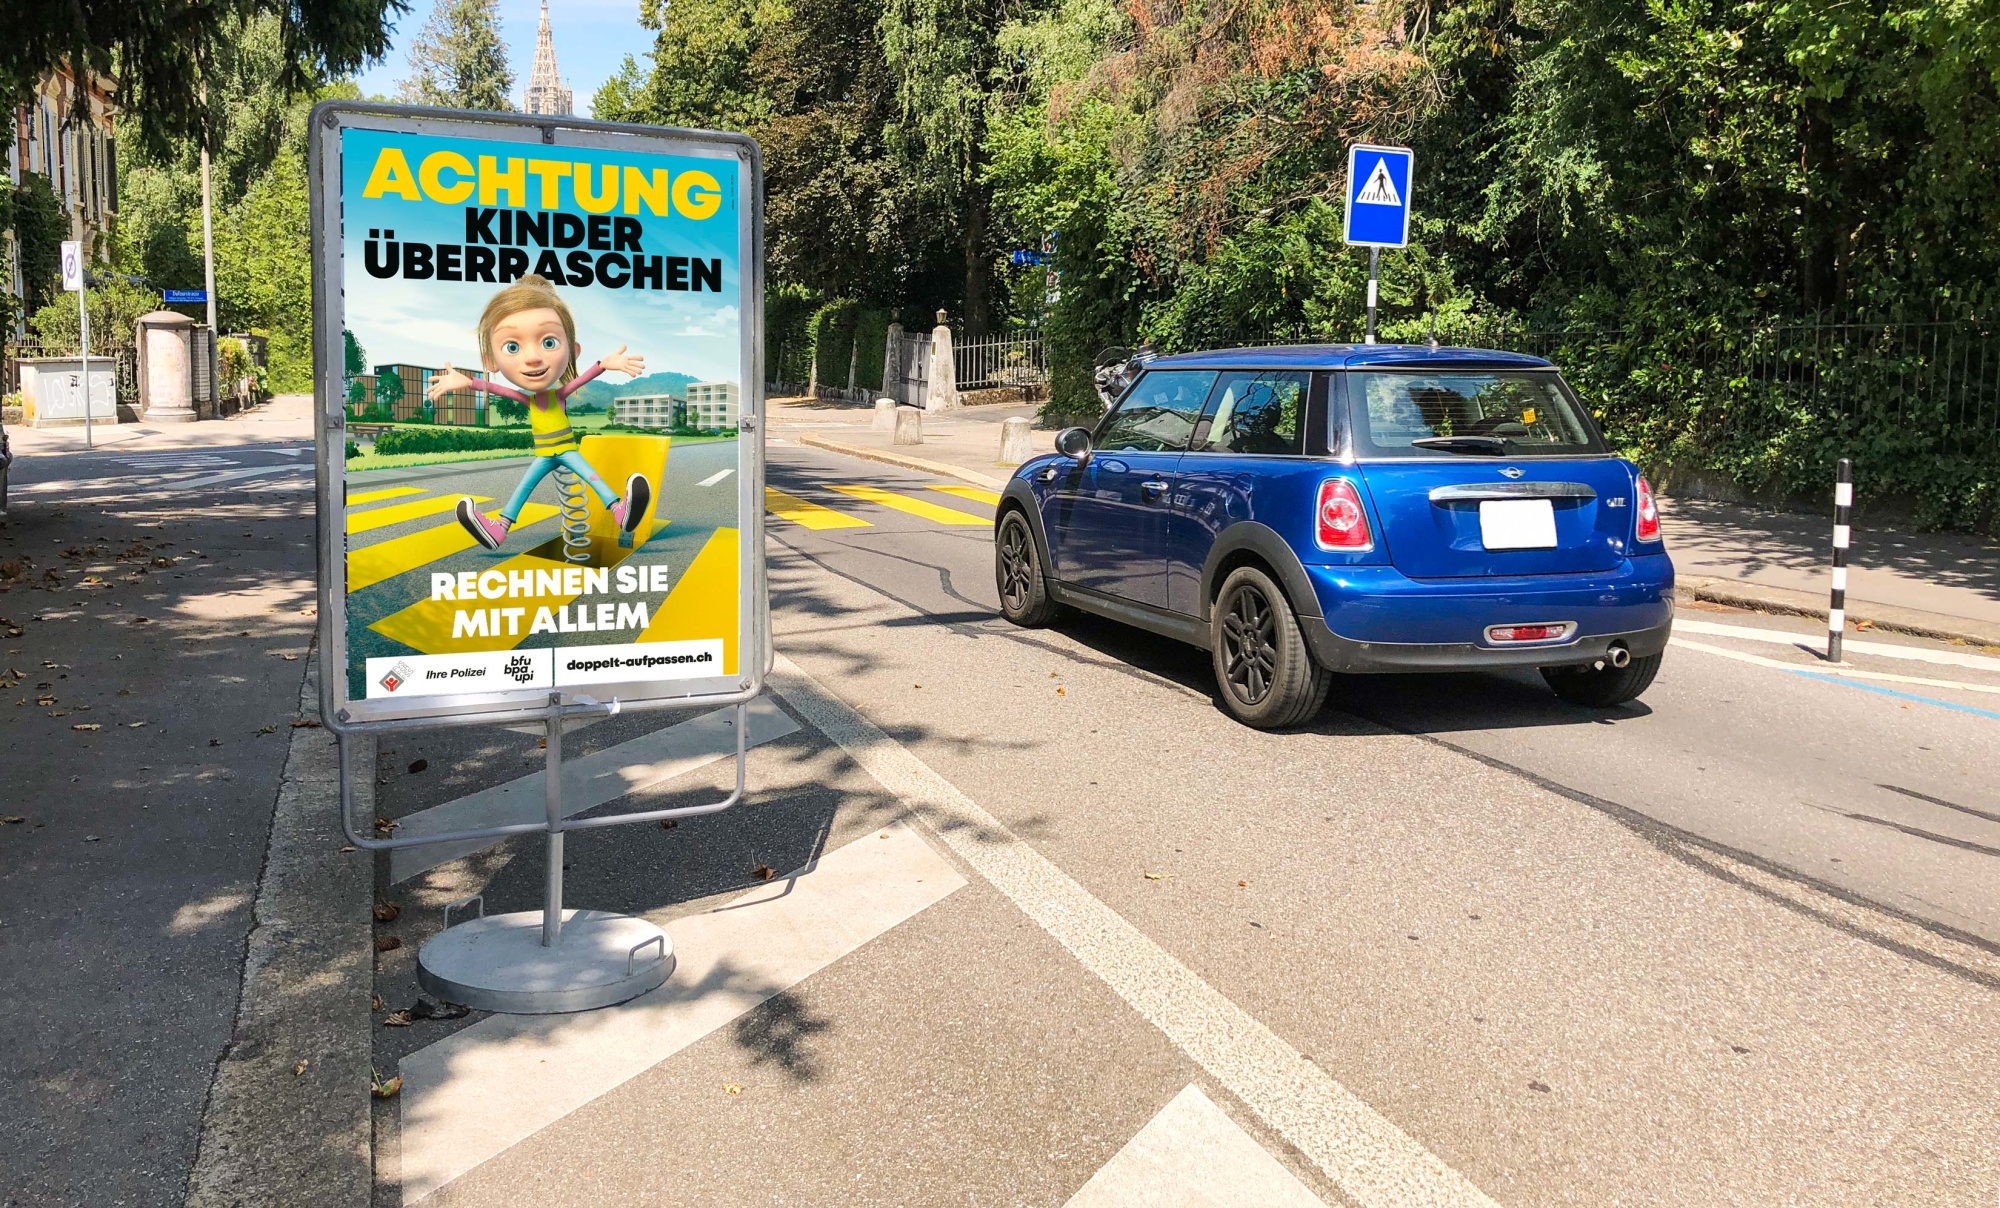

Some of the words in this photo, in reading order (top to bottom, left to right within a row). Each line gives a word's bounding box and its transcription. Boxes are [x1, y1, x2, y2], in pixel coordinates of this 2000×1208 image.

[362, 148, 722, 220] ACHTUNG
[465, 207, 643, 252] KINDER
[365, 229, 722, 292] ÜBERRASCHEN
[431, 567, 609, 601] RECHNEN
[616, 564, 669, 594] SIE
[452, 607, 525, 638] MIT
[529, 601, 649, 635] ALLEM
[426, 669, 448, 680] Ihre
[451, 667, 487, 679] Polizei
[503, 664, 529, 677] bpa
[511, 655, 532, 667] bfu
[566, 651, 713, 673] doppelt-aufpassen.ch
[515, 671, 534, 684] upi
